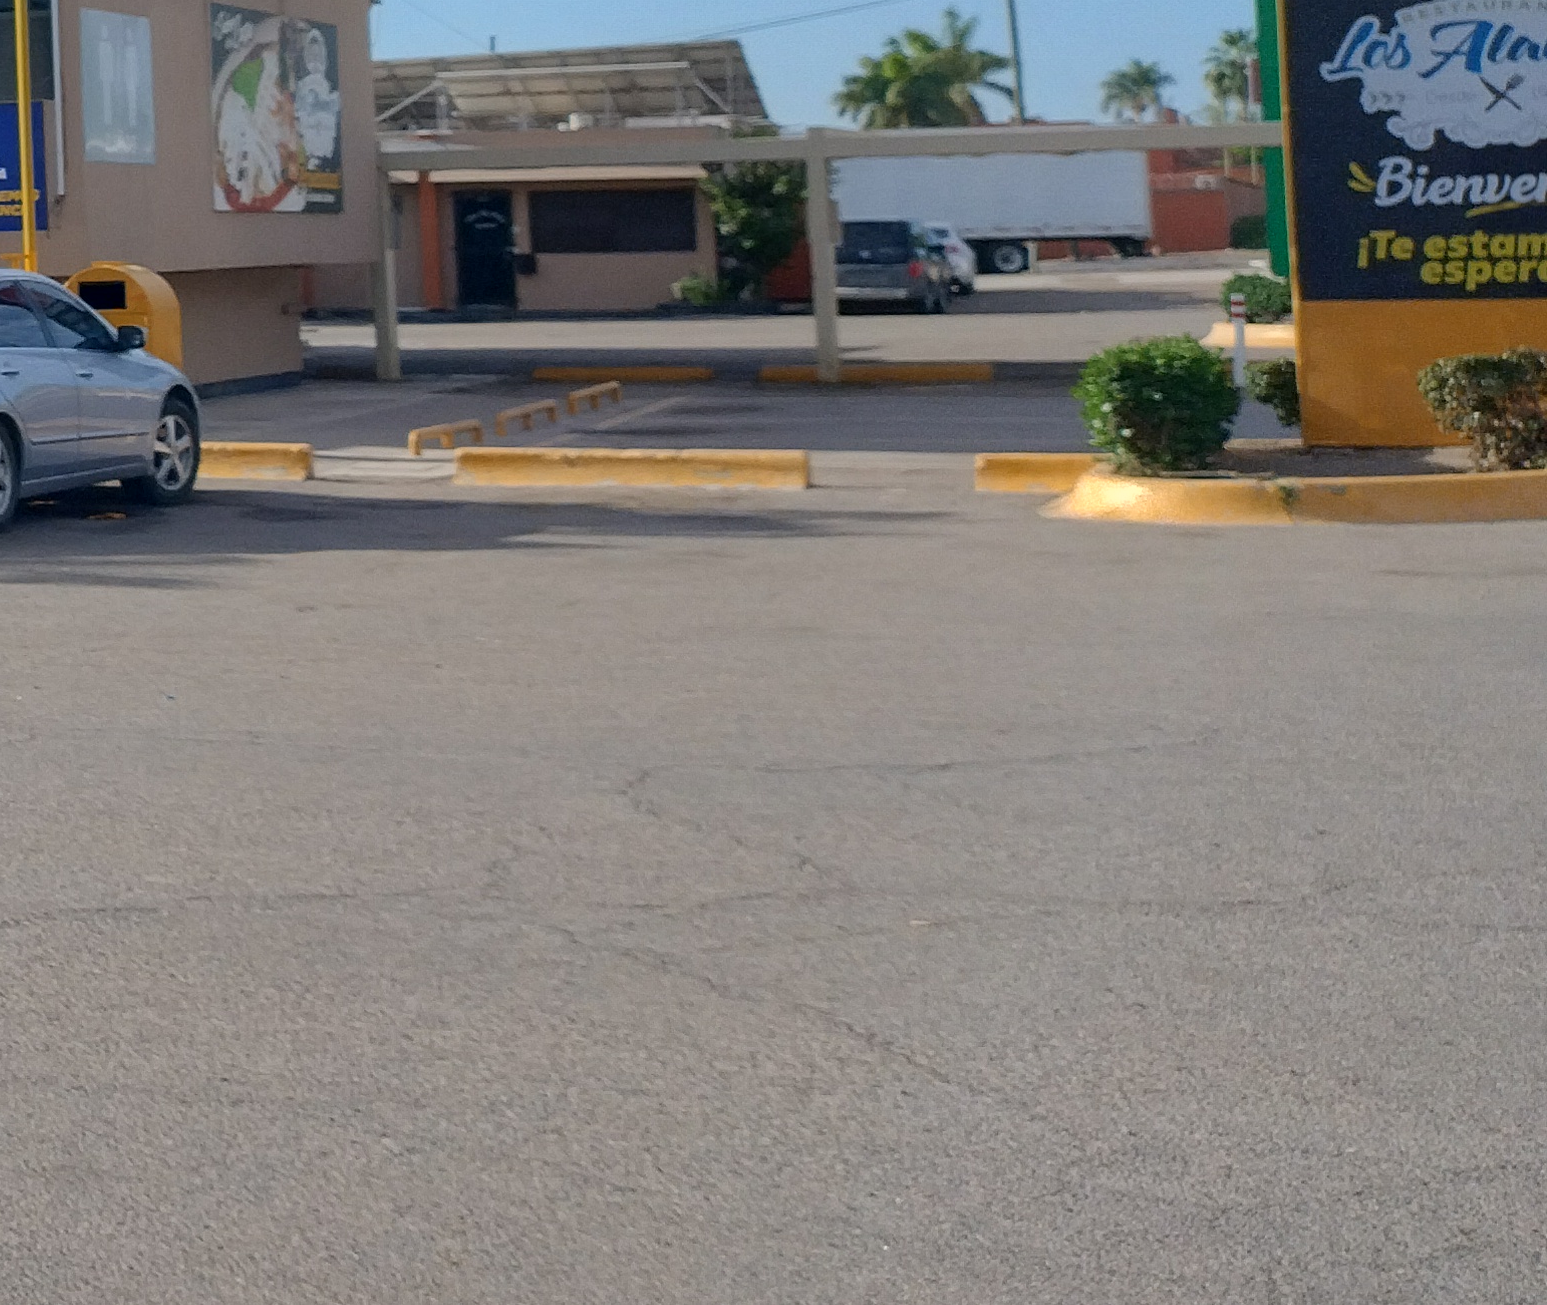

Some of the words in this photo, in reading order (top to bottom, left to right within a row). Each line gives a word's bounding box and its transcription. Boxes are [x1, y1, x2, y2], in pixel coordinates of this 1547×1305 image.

[1327, 21, 1411, 73] Los
[1417, 18, 1547, 79] Ala
[1358, 229, 1415, 269] ¡Te
